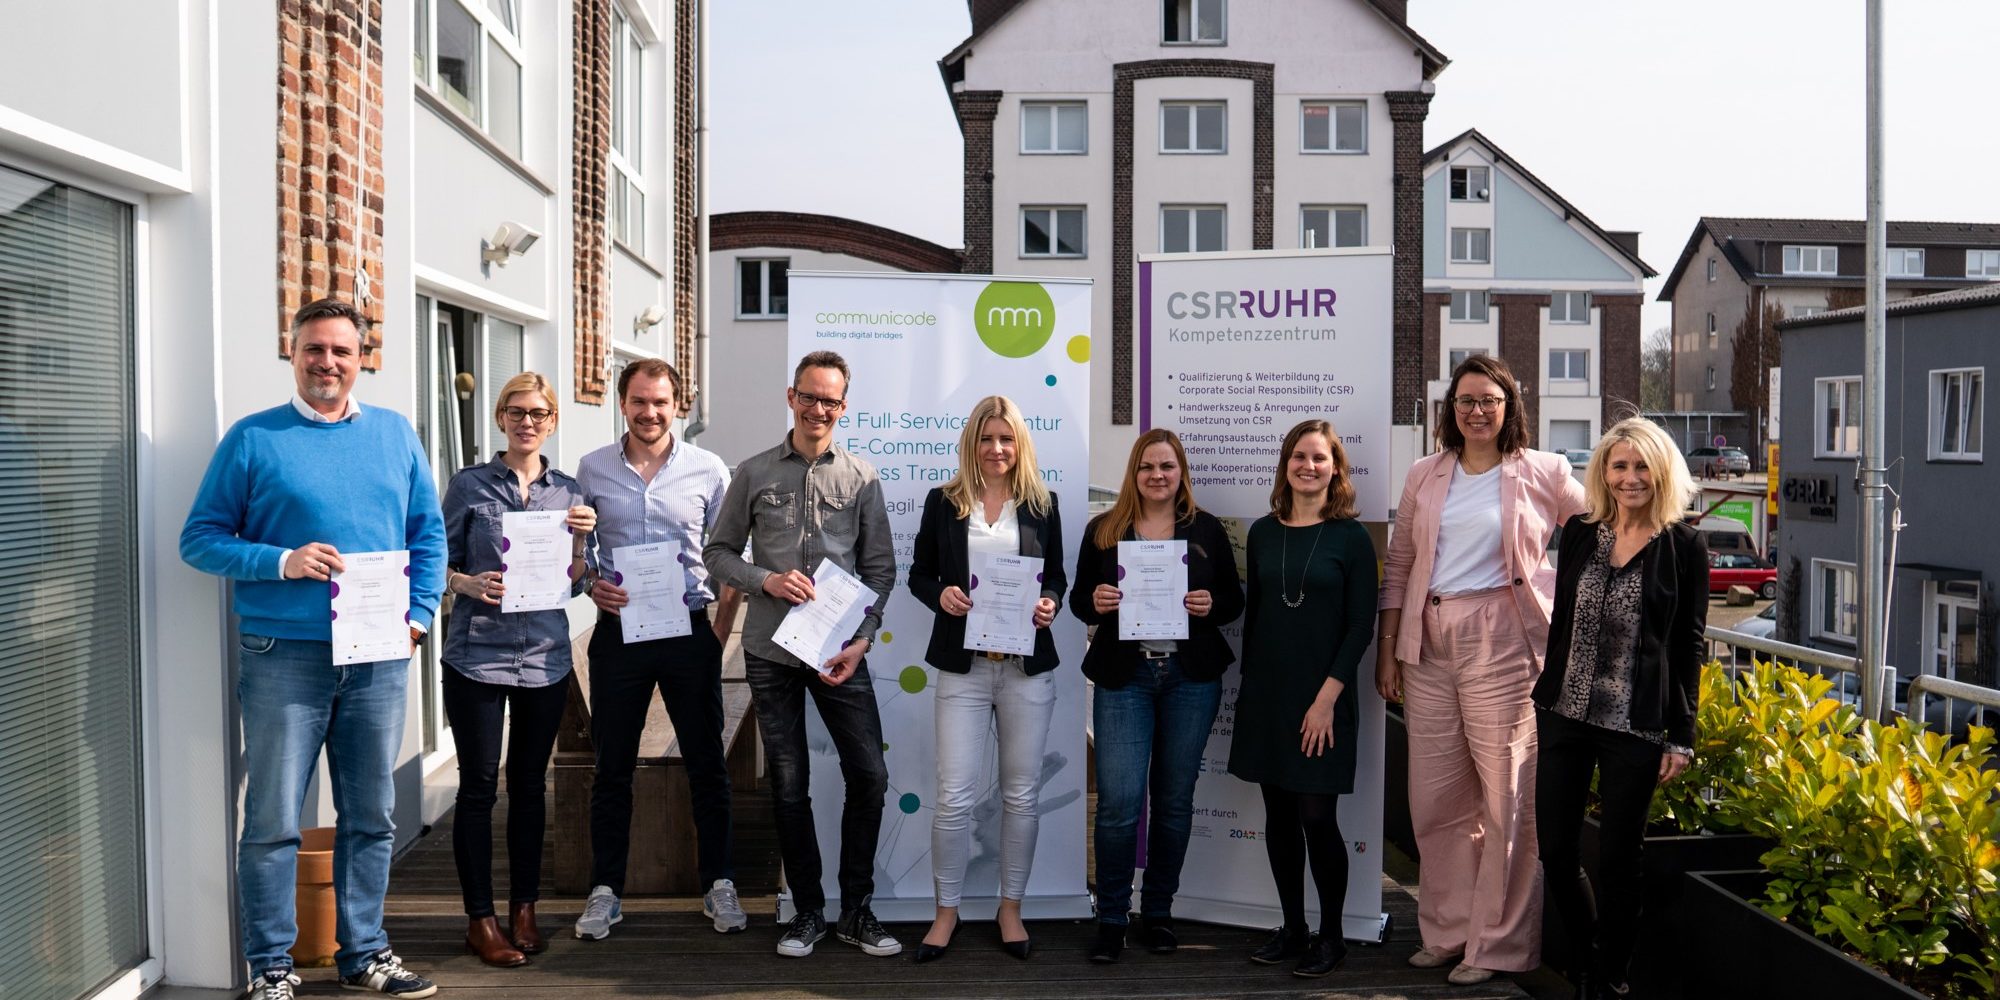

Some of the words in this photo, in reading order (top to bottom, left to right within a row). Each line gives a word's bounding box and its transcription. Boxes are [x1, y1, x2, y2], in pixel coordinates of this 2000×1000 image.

[816, 310, 936, 326] communicode
[816, 331, 846, 340] building
[849, 331, 872, 340] digital
[875, 332, 903, 340] bridges
[1169, 327, 1336, 344] Kompetenzzentrum
[1179, 372, 1242, 383] Qualifizierung
[1256, 372, 1320, 382] Weiterbildung
[1179, 386, 1224, 396] Corporate
[1228, 386, 1254, 394] Social
[1258, 385, 1324, 396] Responsibility
[1326, 385, 1354, 395] (CSR)
[1179, 403, 1251, 414] Handwerkszeug
[1254, 404, 1260, 412] &
[1264, 404, 1320, 414] Anregungen
[858, 412, 969, 429] Full-Service
[1179, 416, 1230, 426] Umsetzung
[1252, 416, 1272, 424] CSR
[1180, 433, 1276, 444] Erfahrungsaustausch
[1346, 435, 1362, 444] mit
[848, 438, 960, 454] E-Commerc
[1184, 446, 1216, 454] nderen
[1218, 446, 1281, 456] Unternehmen
[1211, 464, 1278, 474] Kooperationsp
[1191, 476, 1236, 486] gagement
[1256, 478, 1272, 486] Ort
[886, 498, 914, 515] agil
[1212, 808, 1238, 818] durch
